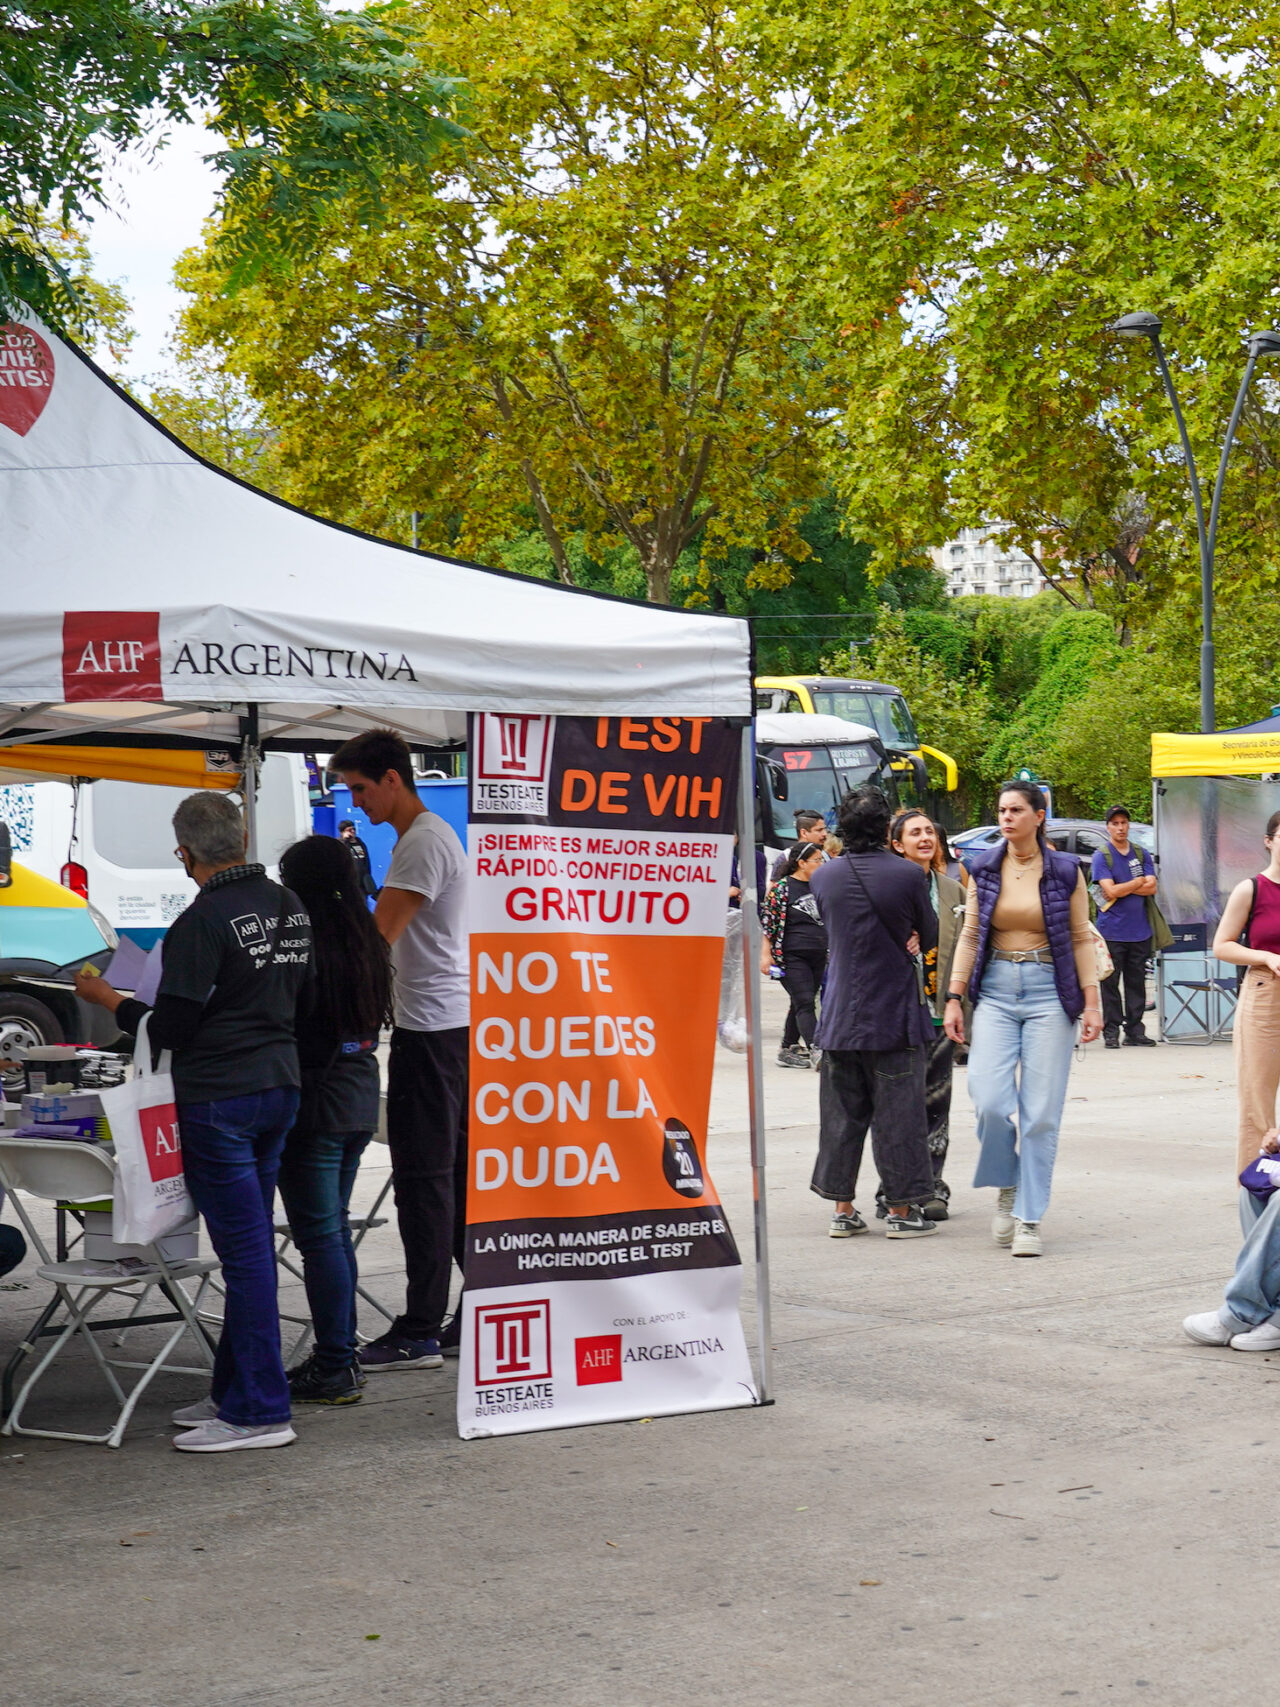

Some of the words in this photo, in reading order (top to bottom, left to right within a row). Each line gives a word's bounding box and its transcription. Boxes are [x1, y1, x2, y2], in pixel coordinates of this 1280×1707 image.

[76, 640, 145, 673] AHF
[170, 642, 419, 682] ARGENTINA
[597, 716, 713, 754] TEST
[1259, 740, 1268, 748] de
[783, 751, 812, 770] 57
[476, 800, 522, 811] BUENOS
[524, 801, 545, 812] AIRES
[477, 783, 545, 801] TESTEATE
[560, 768, 632, 814] DE
[643, 773, 722, 819] VIH
[478, 833, 557, 854] ¡SIEMPRE
[561, 837, 581, 853] ES
[586, 839, 650, 856] MEJOR
[655, 841, 719, 859] SABER!
[477, 855, 558, 877] RÁPIDO
[567, 860, 717, 883] CONFIDENCIAL
[505, 887, 690, 925] GRATUITO
[240, 921, 259, 937] AHF
[477, 951, 558, 994] NO
[570, 951, 613, 993] TE
[475, 1015, 657, 1062] QUEDES
[475, 1079, 591, 1125] CON
[606, 1078, 658, 1119] LA
[475, 1142, 621, 1191] DUDA
[674, 1151, 695, 1176] 20
[475, 1237, 497, 1254] LA
[500, 1232, 554, 1251] ÚNICA
[558, 1228, 629, 1247] MANERA
[631, 1225, 652, 1241] DE
[655, 1220, 710, 1239] SABER
[712, 1219, 728, 1234] ES
[518, 1249, 628, 1270] HACIENDOTE
[630, 1246, 649, 1262] EL
[651, 1242, 694, 1259] TEST
[612, 1318, 635, 1327] CON
[637, 1316, 648, 1326] EL
[649, 1313, 675, 1325] APOYO
[582, 1348, 614, 1369] AHF
[622, 1337, 724, 1364] ARGENTINA
[475, 1383, 553, 1406] TESTEATE
[475, 1402, 520, 1417] BUENOS
[522, 1399, 554, 1412] AIRES
